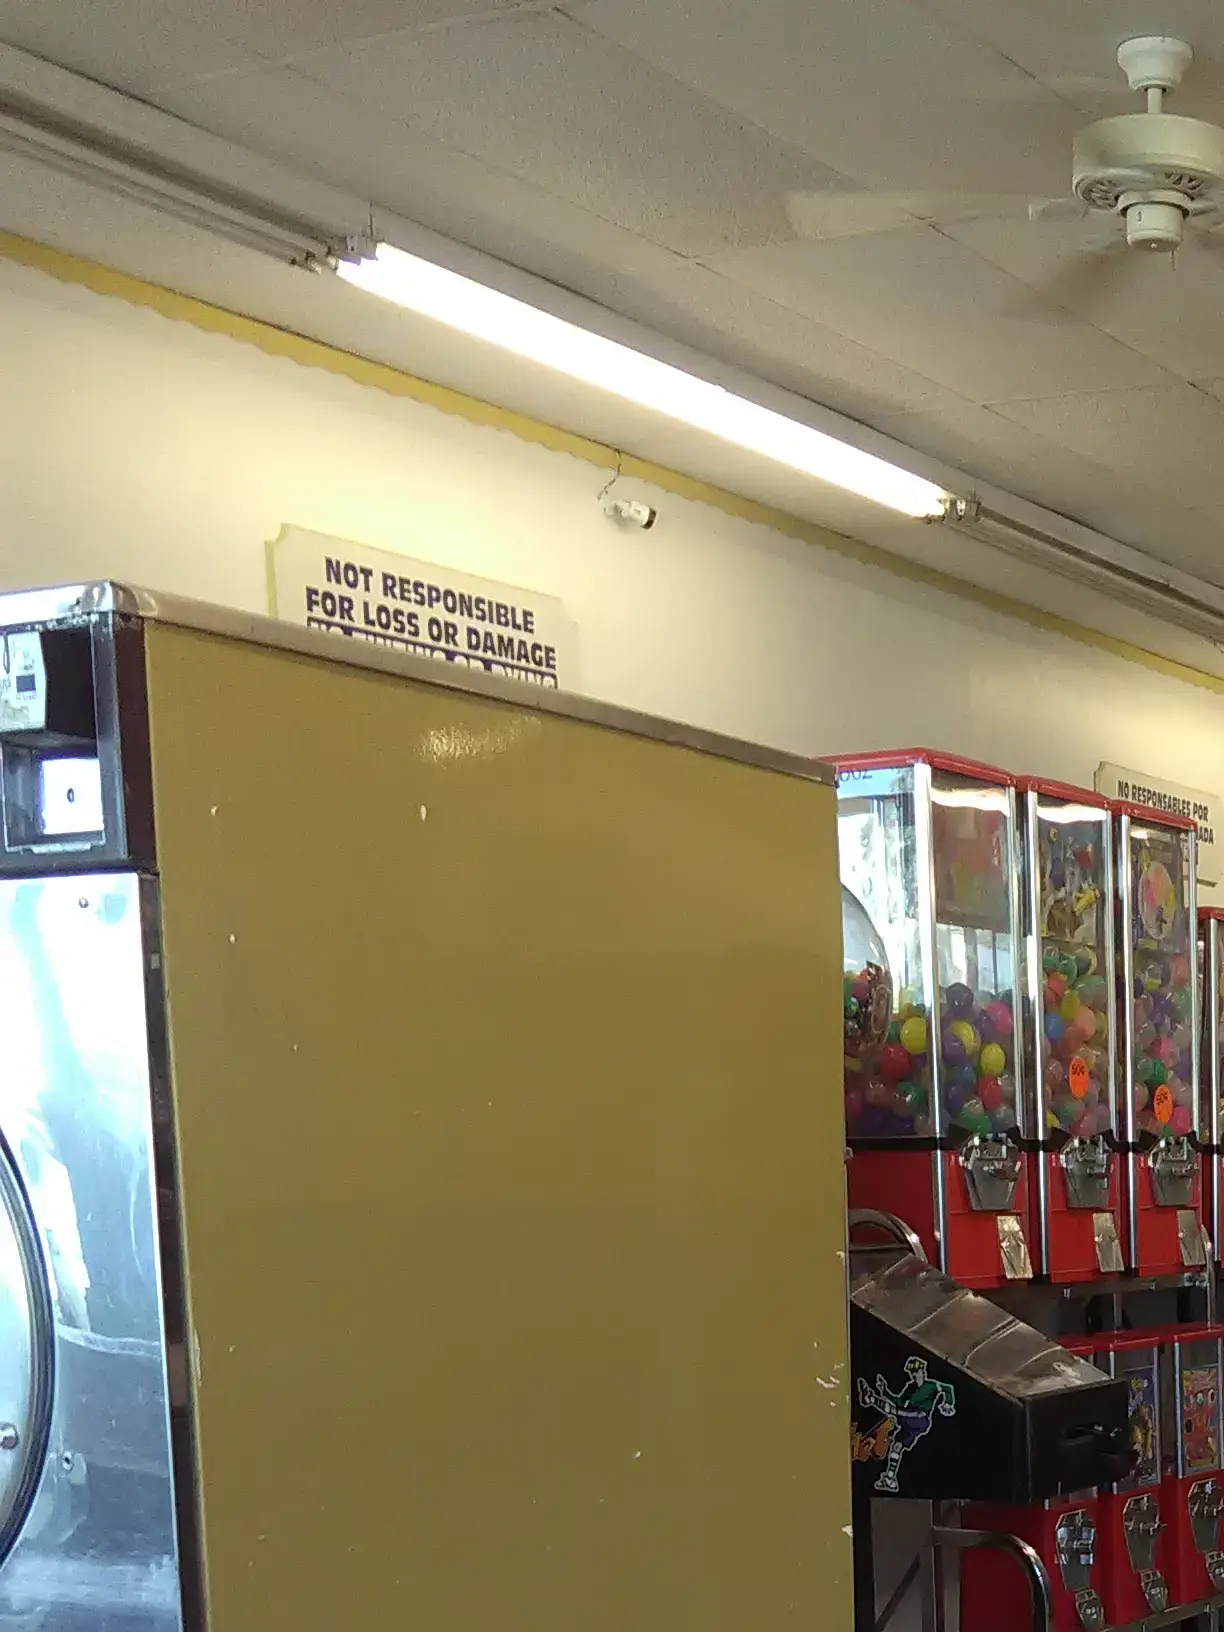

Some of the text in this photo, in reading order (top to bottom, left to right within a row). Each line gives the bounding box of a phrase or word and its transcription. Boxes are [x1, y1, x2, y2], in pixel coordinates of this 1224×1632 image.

[325, 556, 373, 593] NOT
[381, 571, 536, 634] RESPONSIBLE
[305, 586, 356, 622] FOR
[362, 600, 420, 638] LOSS
[427, 616, 460, 647] OR
[466, 625, 557, 671] DAMAGE
[1117, 780, 1209, 823] NO RESPONSABLES POR
[1198, 826, 1215, 845] ADA
